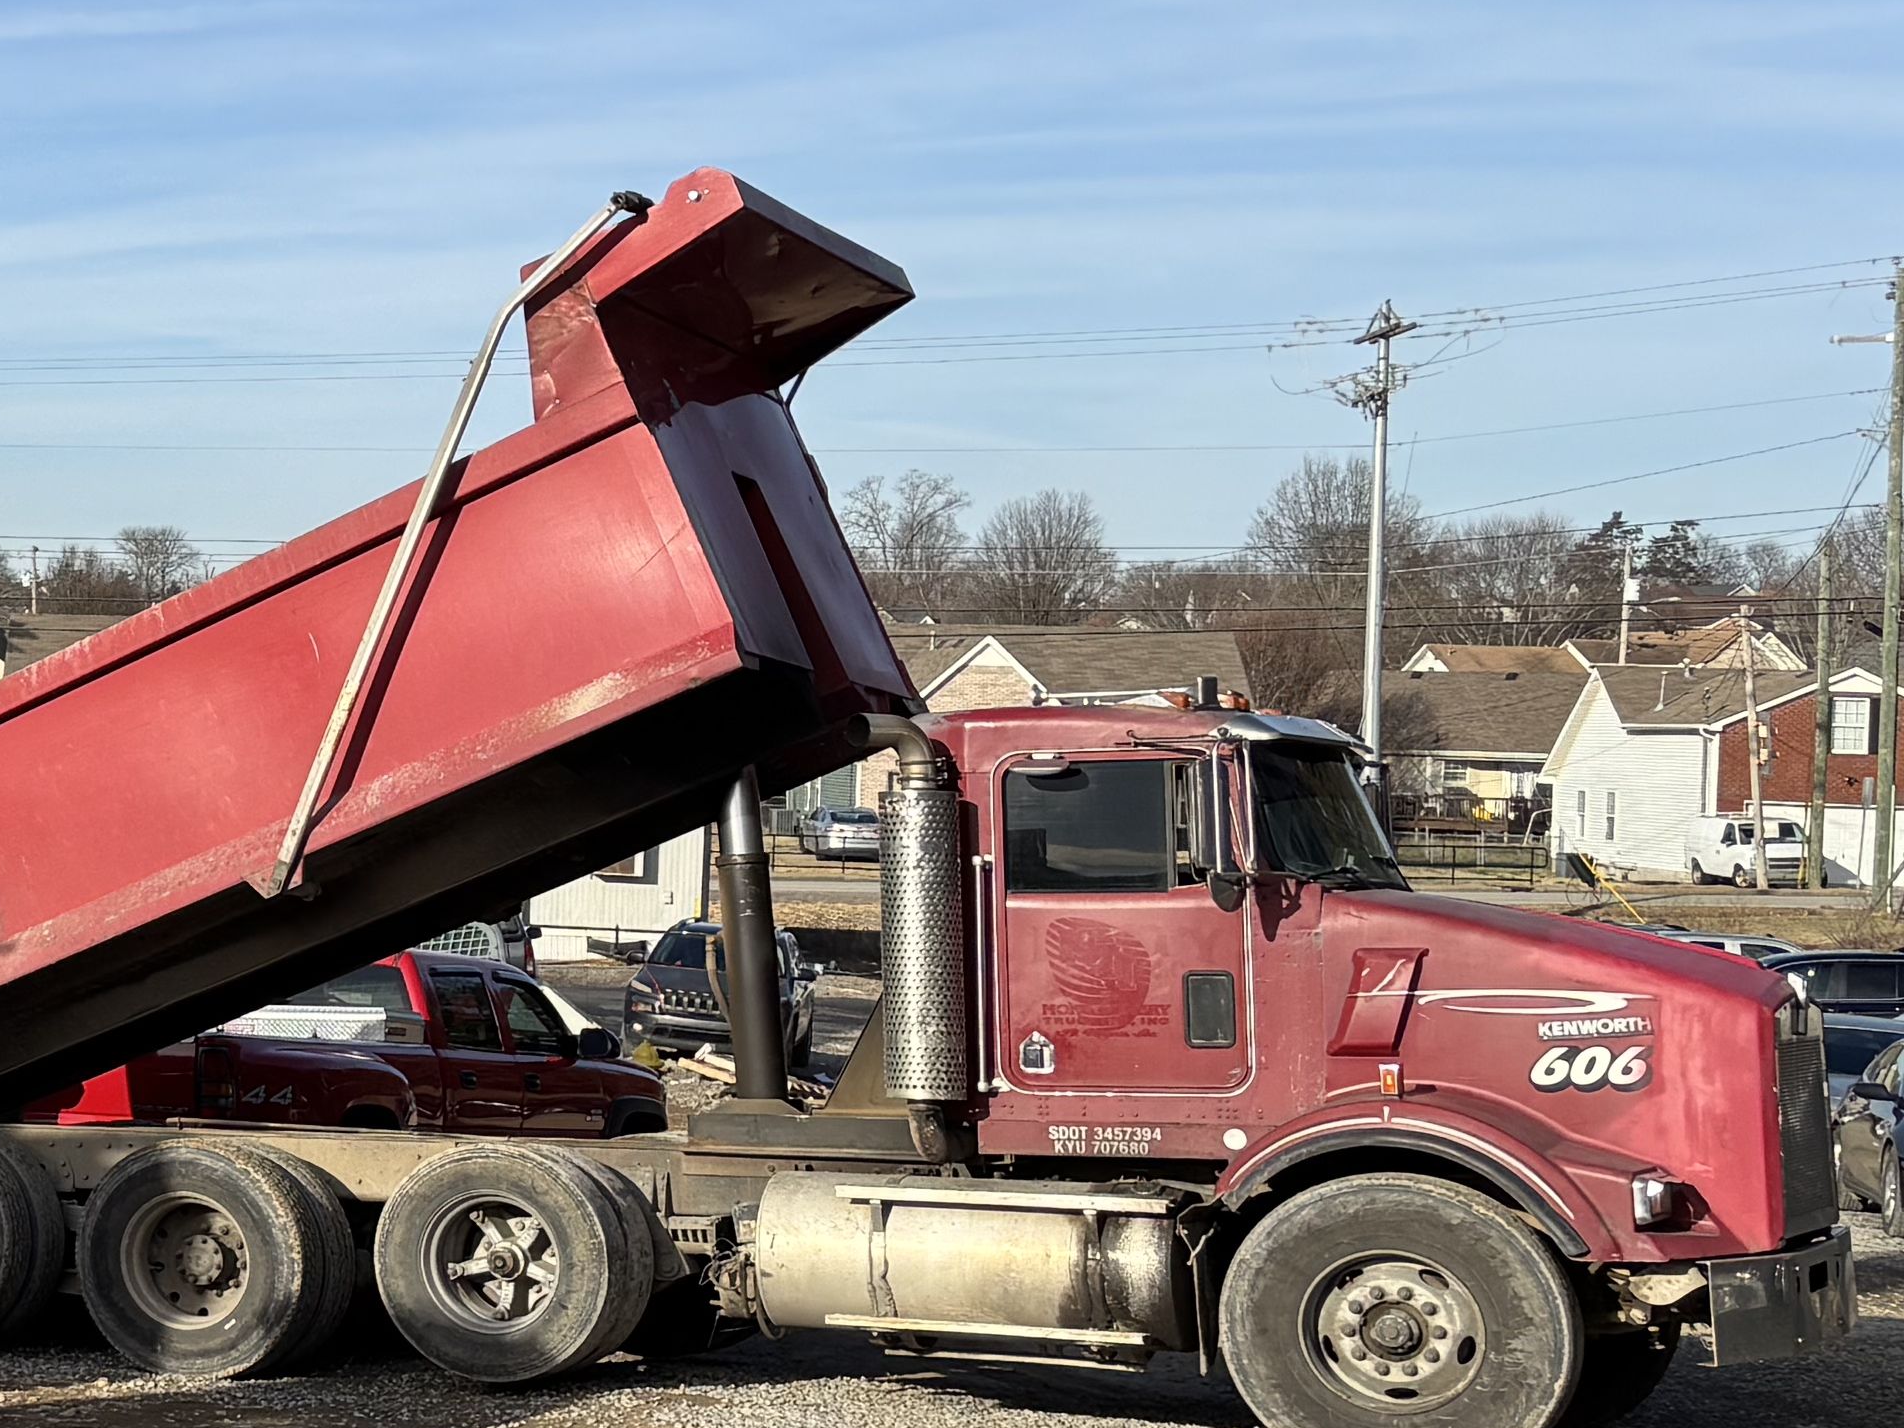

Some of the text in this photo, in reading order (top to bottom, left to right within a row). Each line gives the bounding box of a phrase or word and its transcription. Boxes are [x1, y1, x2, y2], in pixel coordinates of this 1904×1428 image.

[1537, 1016, 1652, 1038] KENWORTH
[1529, 1044, 1650, 1090] 606
[1093, 1127, 1162, 1141] 3457394
[1054, 1140, 1150, 1155] KYU 707680
